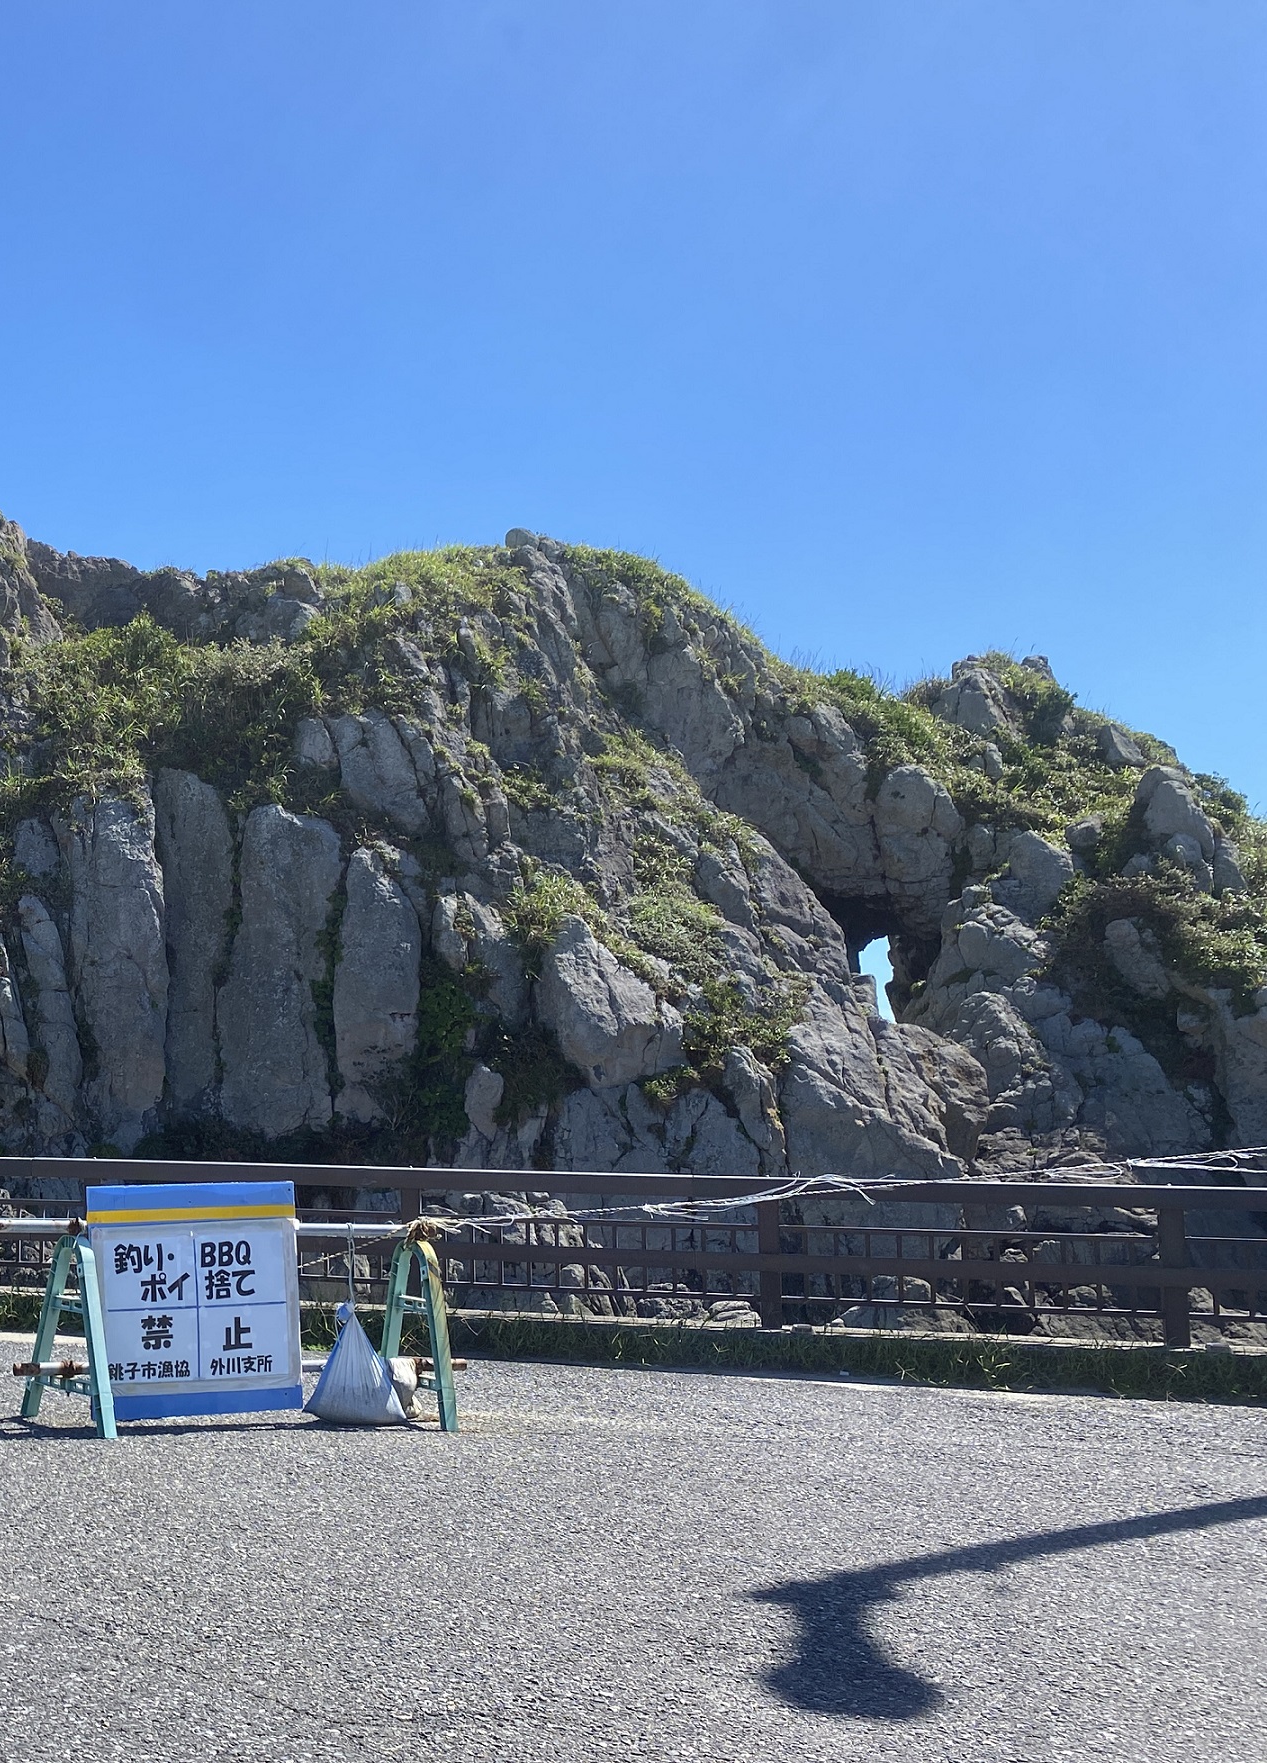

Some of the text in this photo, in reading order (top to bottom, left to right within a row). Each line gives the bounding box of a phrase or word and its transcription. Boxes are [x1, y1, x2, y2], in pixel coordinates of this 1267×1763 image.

[200, 1240, 252, 1268] BBQ
[140, 1269, 256, 1302] ポイ 捨て
[141, 1315, 253, 1351] 禁 止
[210, 1355, 272, 1376] 外川支所
